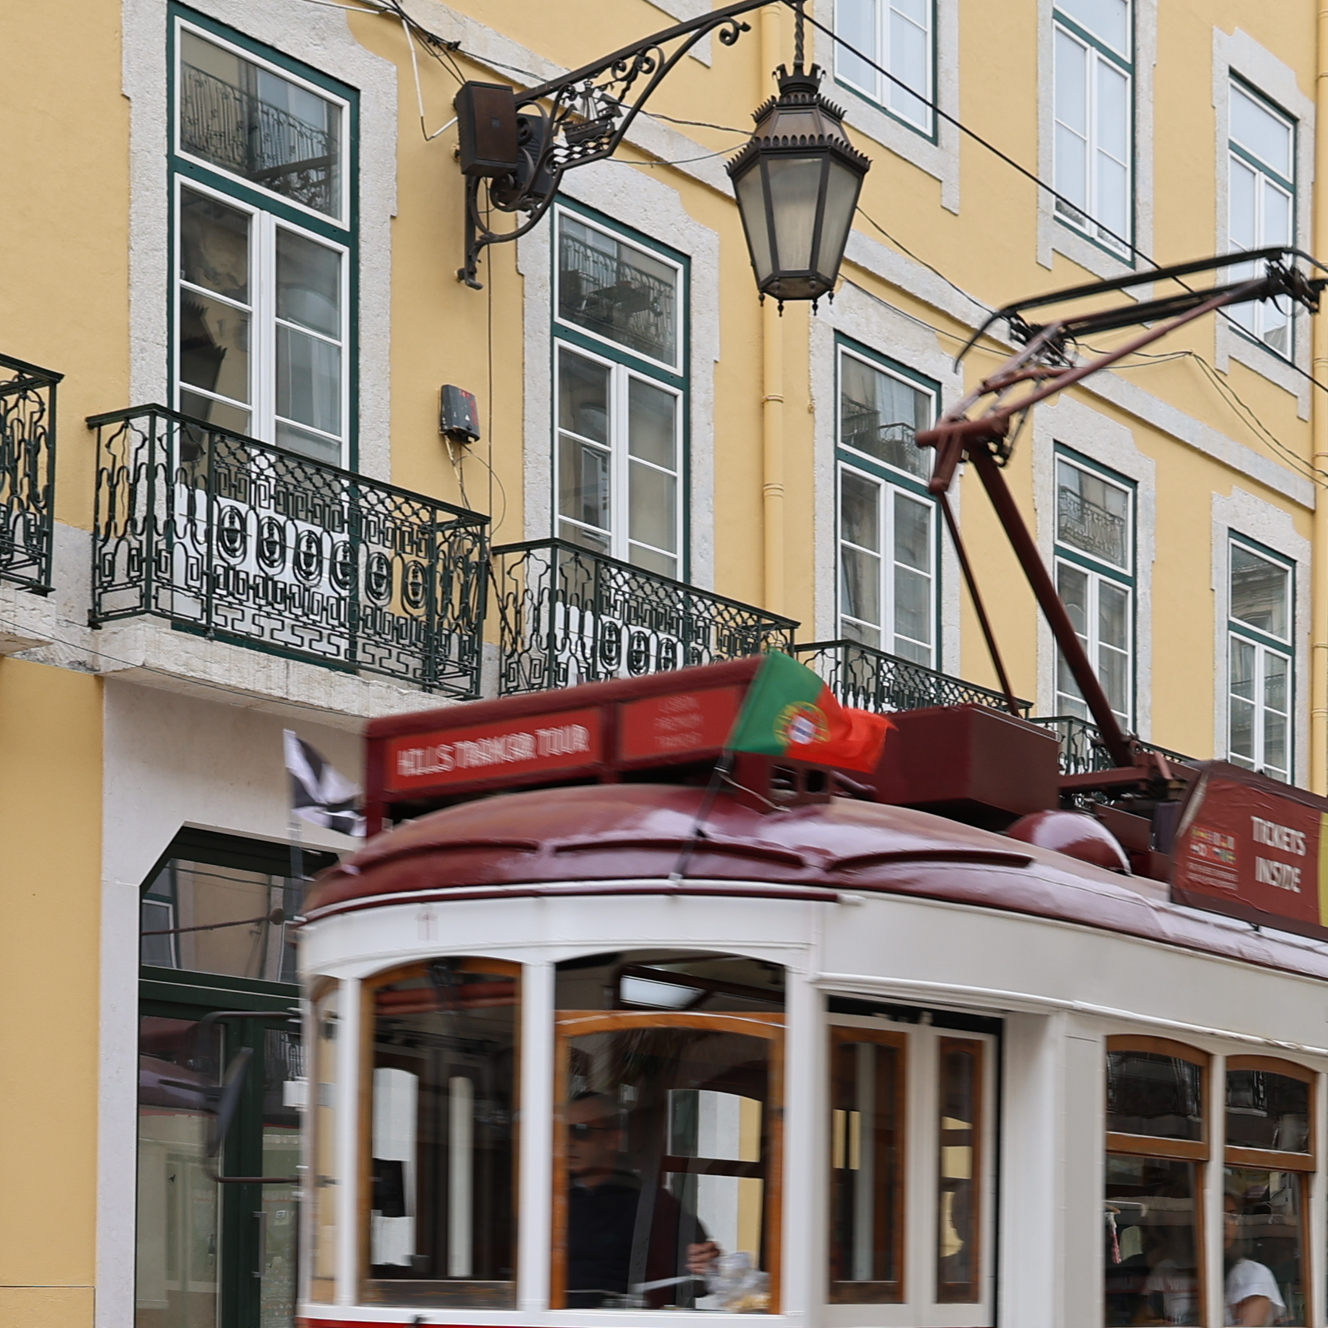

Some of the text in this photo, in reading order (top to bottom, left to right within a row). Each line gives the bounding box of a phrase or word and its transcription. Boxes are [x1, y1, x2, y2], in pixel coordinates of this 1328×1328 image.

[397, 743, 456, 777] HILLS
[535, 723, 591, 757] TOUR
[1251, 815, 1307, 857] TICKETS
[1255, 855, 1302, 894] INSIDE
